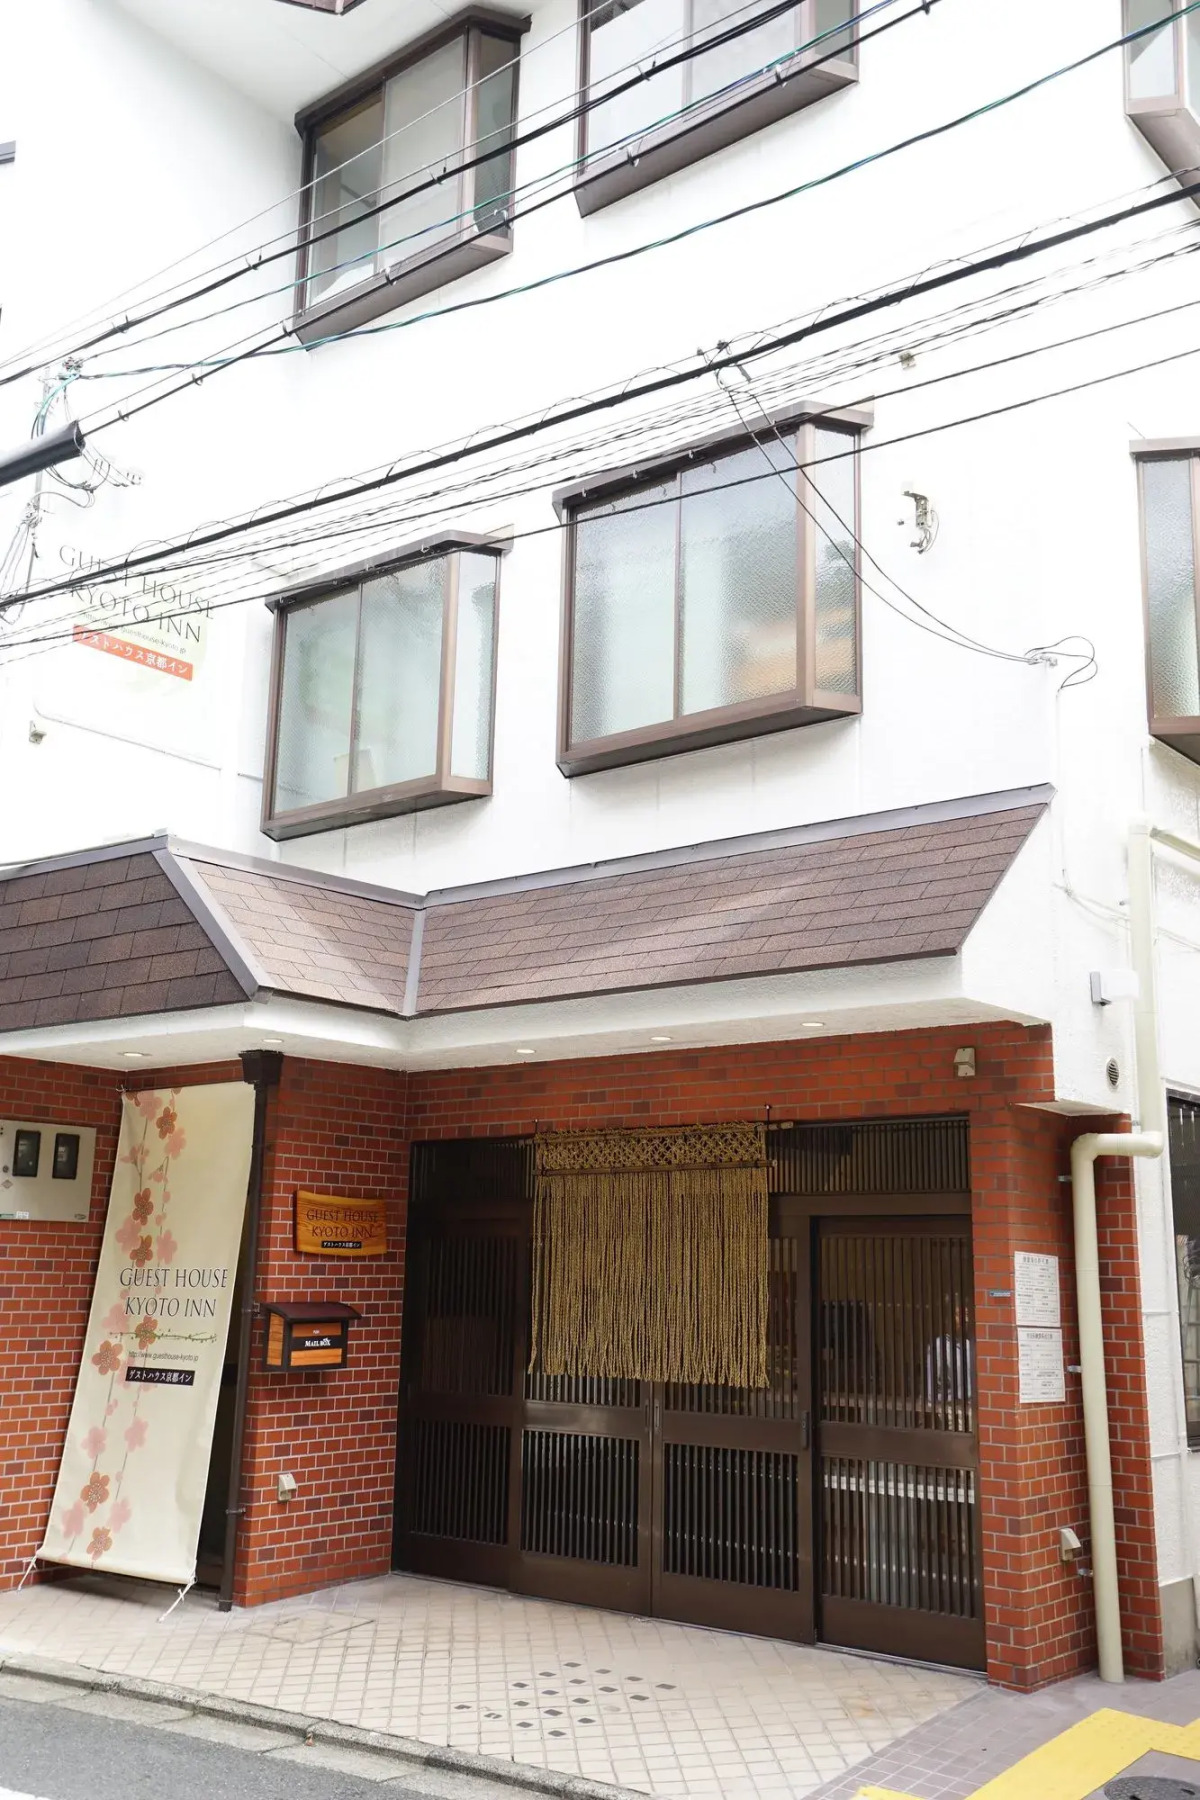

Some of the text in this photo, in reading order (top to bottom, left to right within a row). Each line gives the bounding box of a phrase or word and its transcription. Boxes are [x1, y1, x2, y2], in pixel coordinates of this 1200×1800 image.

[143, 575, 214, 620] HOUSE
[158, 613, 201, 643] INN
[306, 1209, 378, 1223] GUEST HOUSE
[311, 1225, 374, 1238] KYOTO INN
[119, 1267, 228, 1288] GUEST HOUSE
[124, 1297, 217, 1318] KYOTO INN
[129, 1369, 192, 1383] ゲストハウス京都イン
